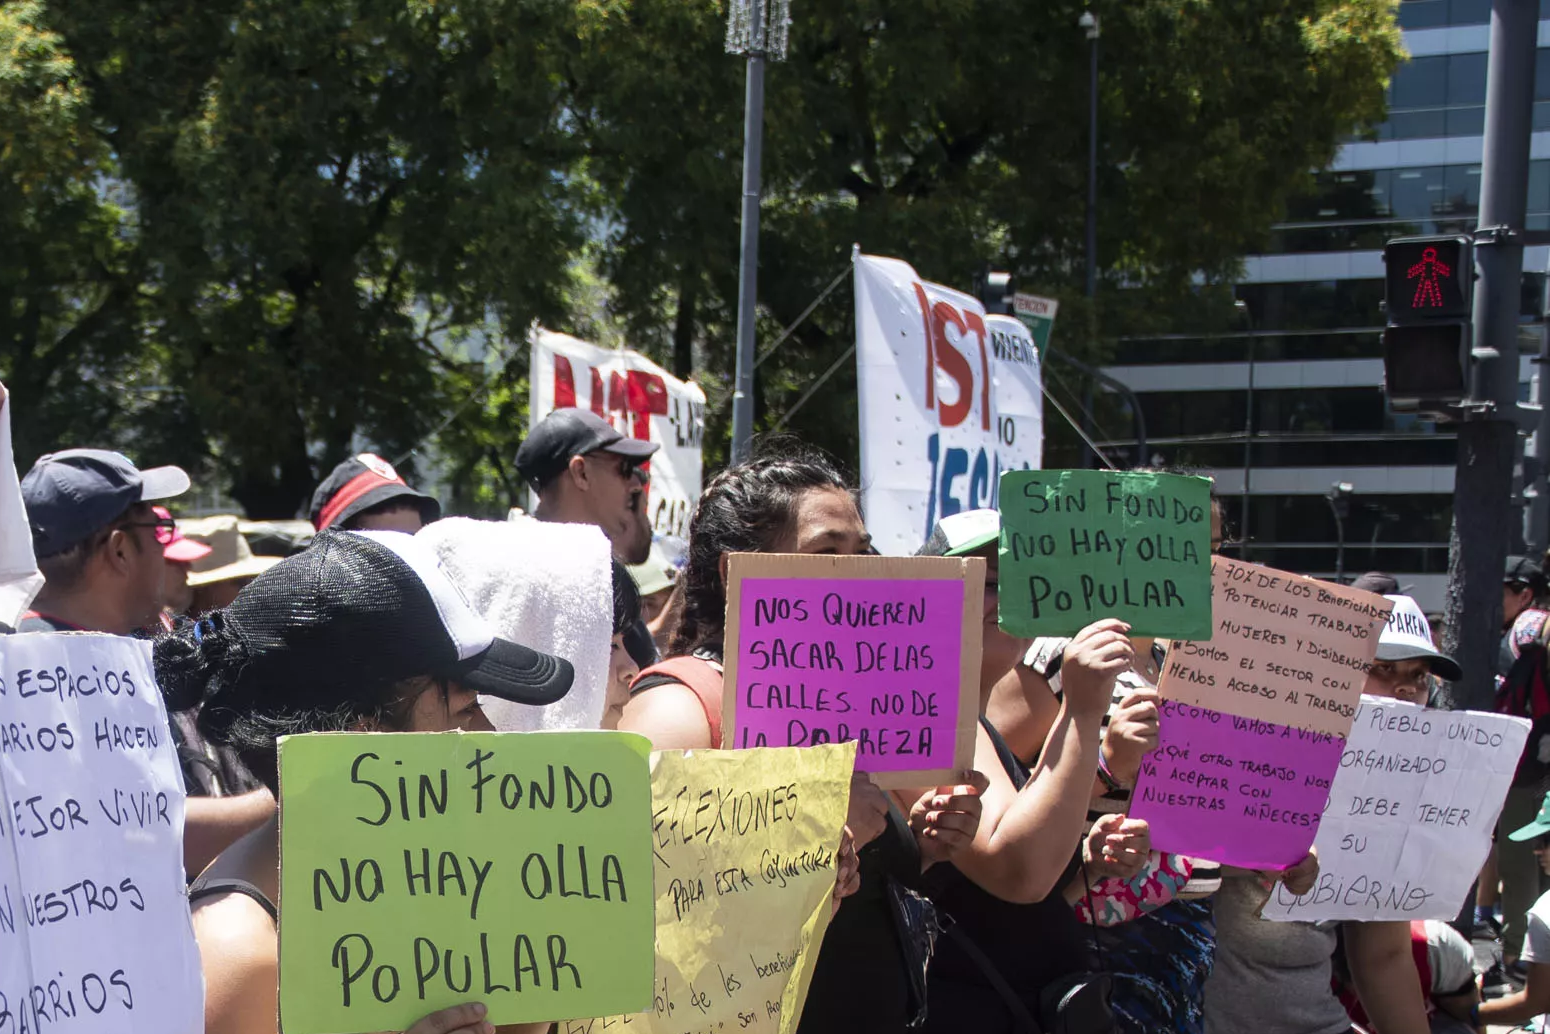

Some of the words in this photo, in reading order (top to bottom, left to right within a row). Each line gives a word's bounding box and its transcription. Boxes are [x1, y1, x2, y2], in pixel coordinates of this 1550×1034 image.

[1024, 481, 1086, 513] SIN
[1106, 481, 1203, 525] FONDO
[1012, 532, 1055, 562] NO
[1070, 527, 1127, 565] HAY
[1137, 533, 1199, 565] OLLA
[1028, 574, 1185, 619] POPULAR
[1257, 573, 1281, 588] DE
[1285, 580, 1311, 598] LOS
[754, 597, 808, 626] NOS
[823, 592, 925, 628] QUIEREN
[1220, 620, 1286, 645] MUJERES
[1296, 639, 1303, 652] Y
[749, 638, 844, 672] SACAR
[17, 664, 136, 701] ESPACIOS
[1169, 662, 1216, 687] MENOS
[1285, 691, 1299, 704] AL
[1305, 693, 1355, 719] TRABAJO
[1239, 657, 1254, 670] EL
[1266, 662, 1314, 683] SECTOR
[1322, 678, 1351, 691] CON
[93, 716, 159, 750] HACEN
[1233, 715, 1276, 736] VAMOS
[1281, 727, 1291, 739] A
[1369, 706, 1432, 735] PUEBLO
[1447, 723, 1503, 748] UNIDO
[1143, 761, 1158, 777] VA
[1239, 784, 1272, 799] CON
[1200, 752, 1234, 767] OTRO
[1239, 760, 1297, 782] TRABAJO
[1304, 775, 1331, 789] NOS
[1339, 749, 1447, 775] ORGANIZADO
[350, 752, 448, 826] SIN
[466, 748, 613, 814] FONDO
[1142, 786, 1227, 811] NUESTRAS
[100, 790, 171, 827] VIVIR
[653, 783, 798, 868] EFLEXIONES
[1347, 796, 1401, 816] DEBE
[1418, 803, 1471, 826] TEMER
[1340, 834, 1368, 853] SU
[313, 856, 385, 912] NO
[403, 847, 494, 920] HAY
[521, 843, 628, 903] OLLA
[667, 878, 705, 922] PARA
[714, 868, 754, 896] ESTA
[331, 932, 582, 1007] POPULAR
[689, 981, 712, 1014] de
[716, 963, 742, 997] les
[738, 1011, 758, 1028] Son
